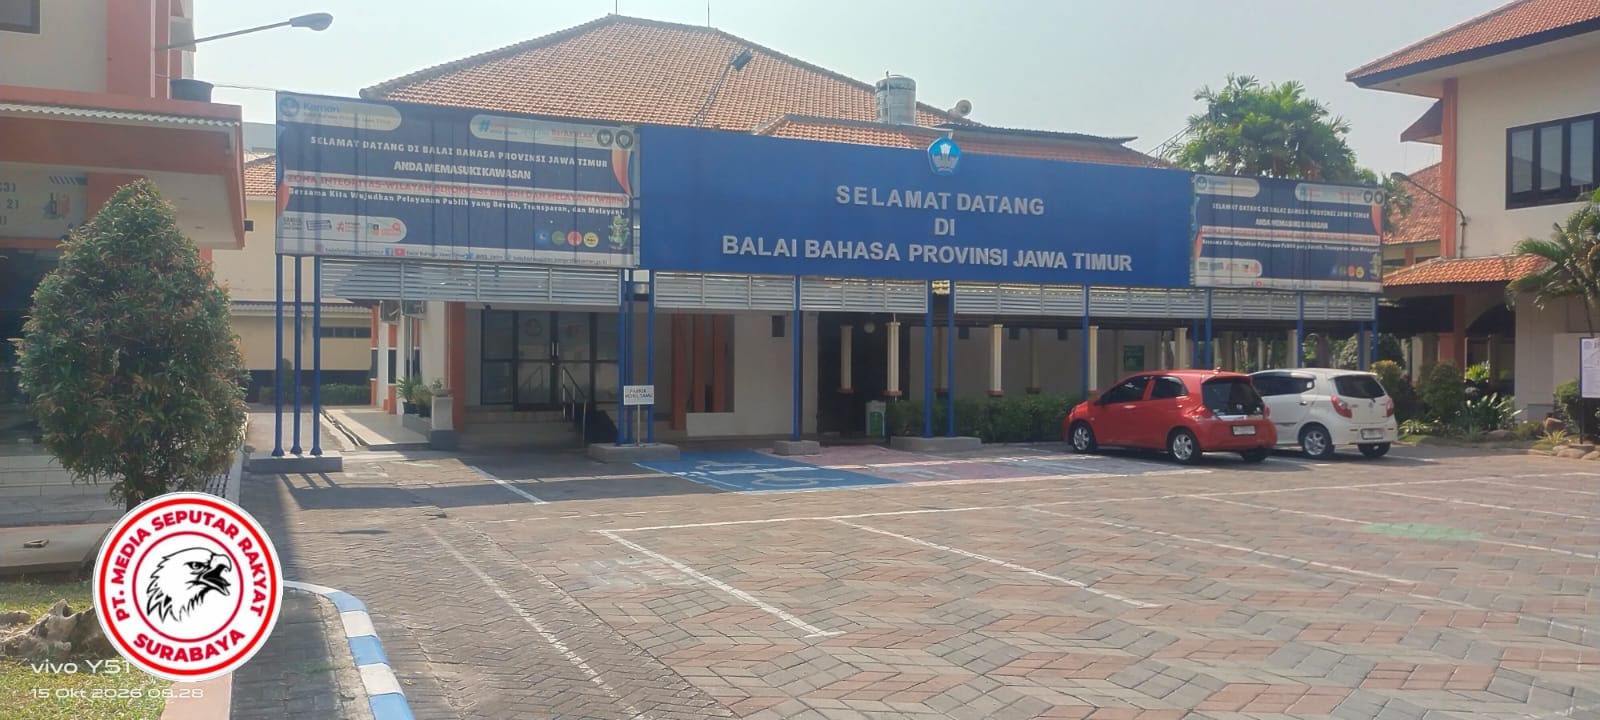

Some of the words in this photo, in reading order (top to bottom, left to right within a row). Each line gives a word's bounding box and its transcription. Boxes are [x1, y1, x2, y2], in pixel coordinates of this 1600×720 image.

[310, 136, 359, 148] SELAMAT
[363, 142, 404, 152] DATANG
[423, 146, 452, 156] BALAI
[456, 148, 494, 159] BAHASA
[498, 150, 546, 163] PROVINSI
[549, 156, 575, 165] JAWA
[578, 158, 608, 168] TIMUR
[394, 160, 423, 172] ANDA
[424, 162, 481, 176] MEMASUKI
[482, 166, 531, 180] KAWASAN
[288, 188, 327, 197] Bersama
[471, 200, 493, 209] yang
[836, 184, 952, 211] SELAMAT
[956, 192, 1045, 216] DATANG
[934, 218, 955, 237] DI
[722, 235, 797, 257] BALAI
[805, 240, 900, 261] BAHASA
[909, 244, 1008, 266] PROVINSI
[1013, 250, 1067, 269] JAWA
[1072, 252, 1132, 272] TIMUR
